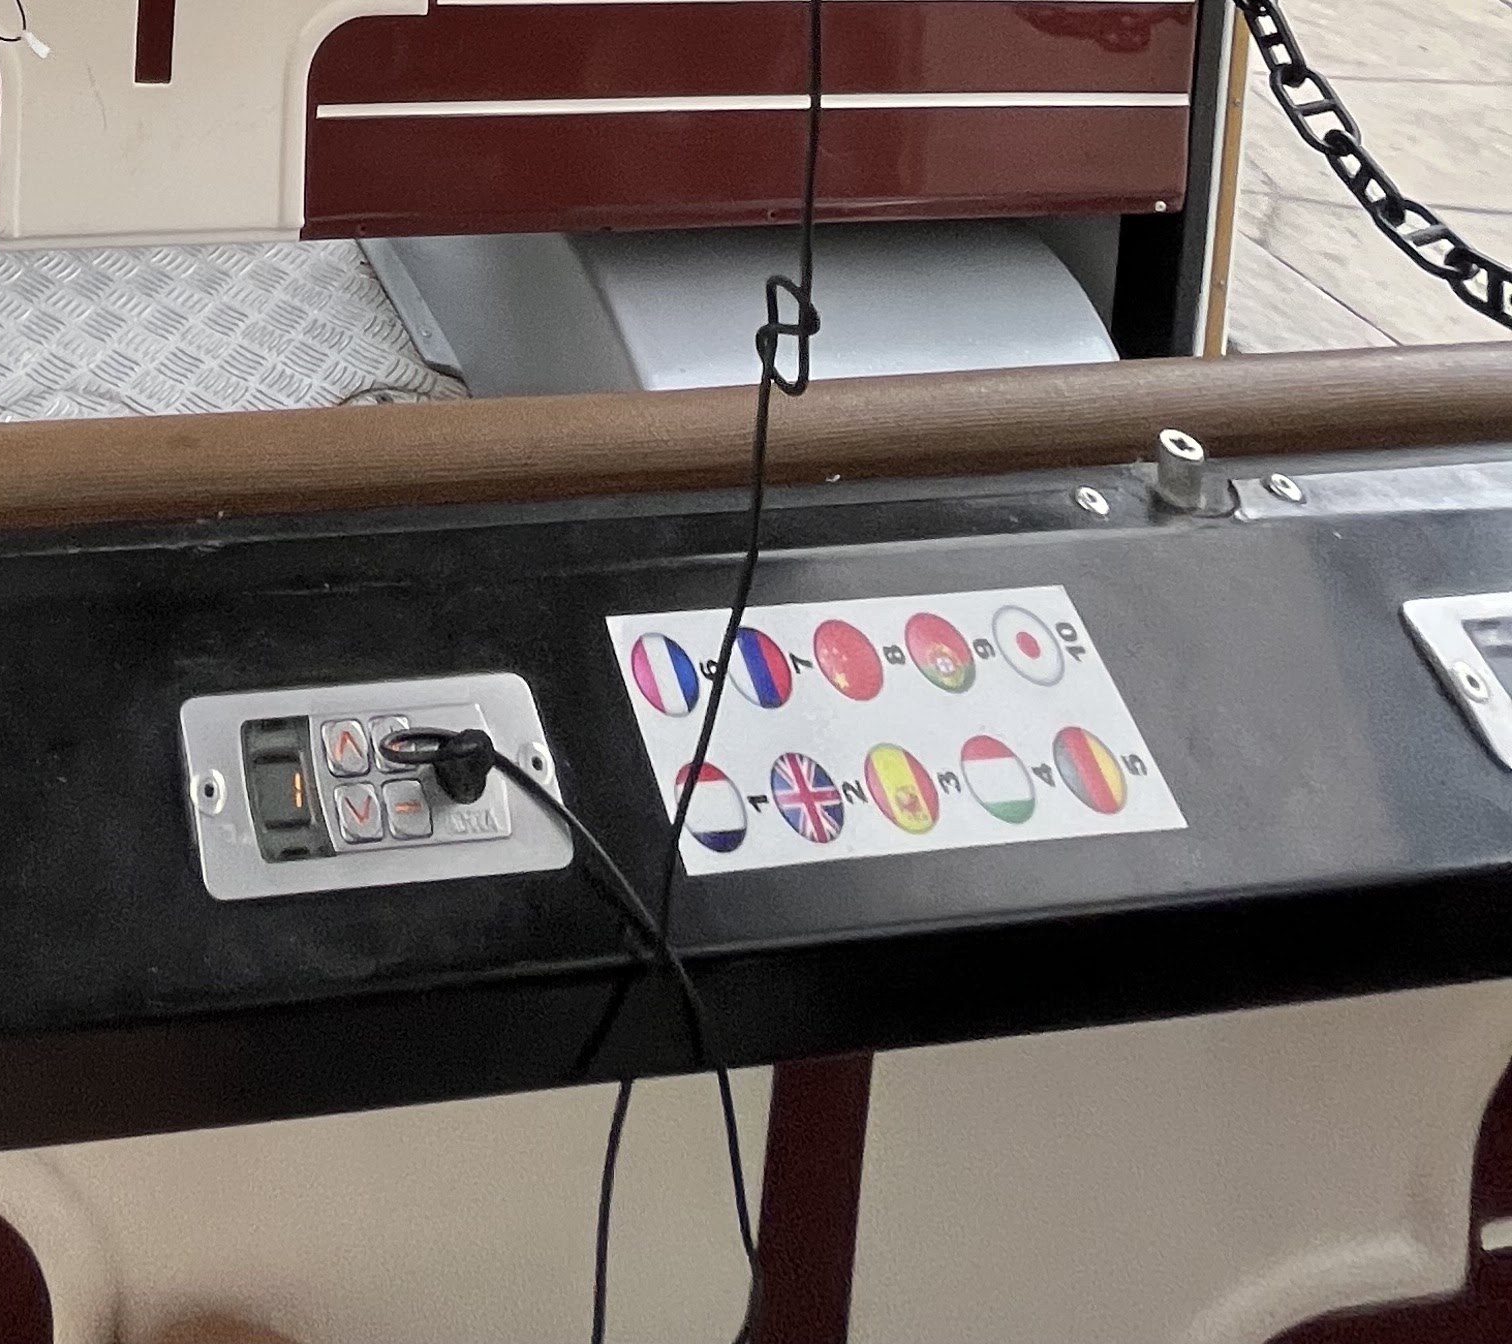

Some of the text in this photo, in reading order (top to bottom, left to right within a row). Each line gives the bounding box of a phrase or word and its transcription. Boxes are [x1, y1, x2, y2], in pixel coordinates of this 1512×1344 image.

[698, 620, 1088, 682] 6 7 8 9 10
[746, 754, 1149, 814] 1 2 3 4 5
